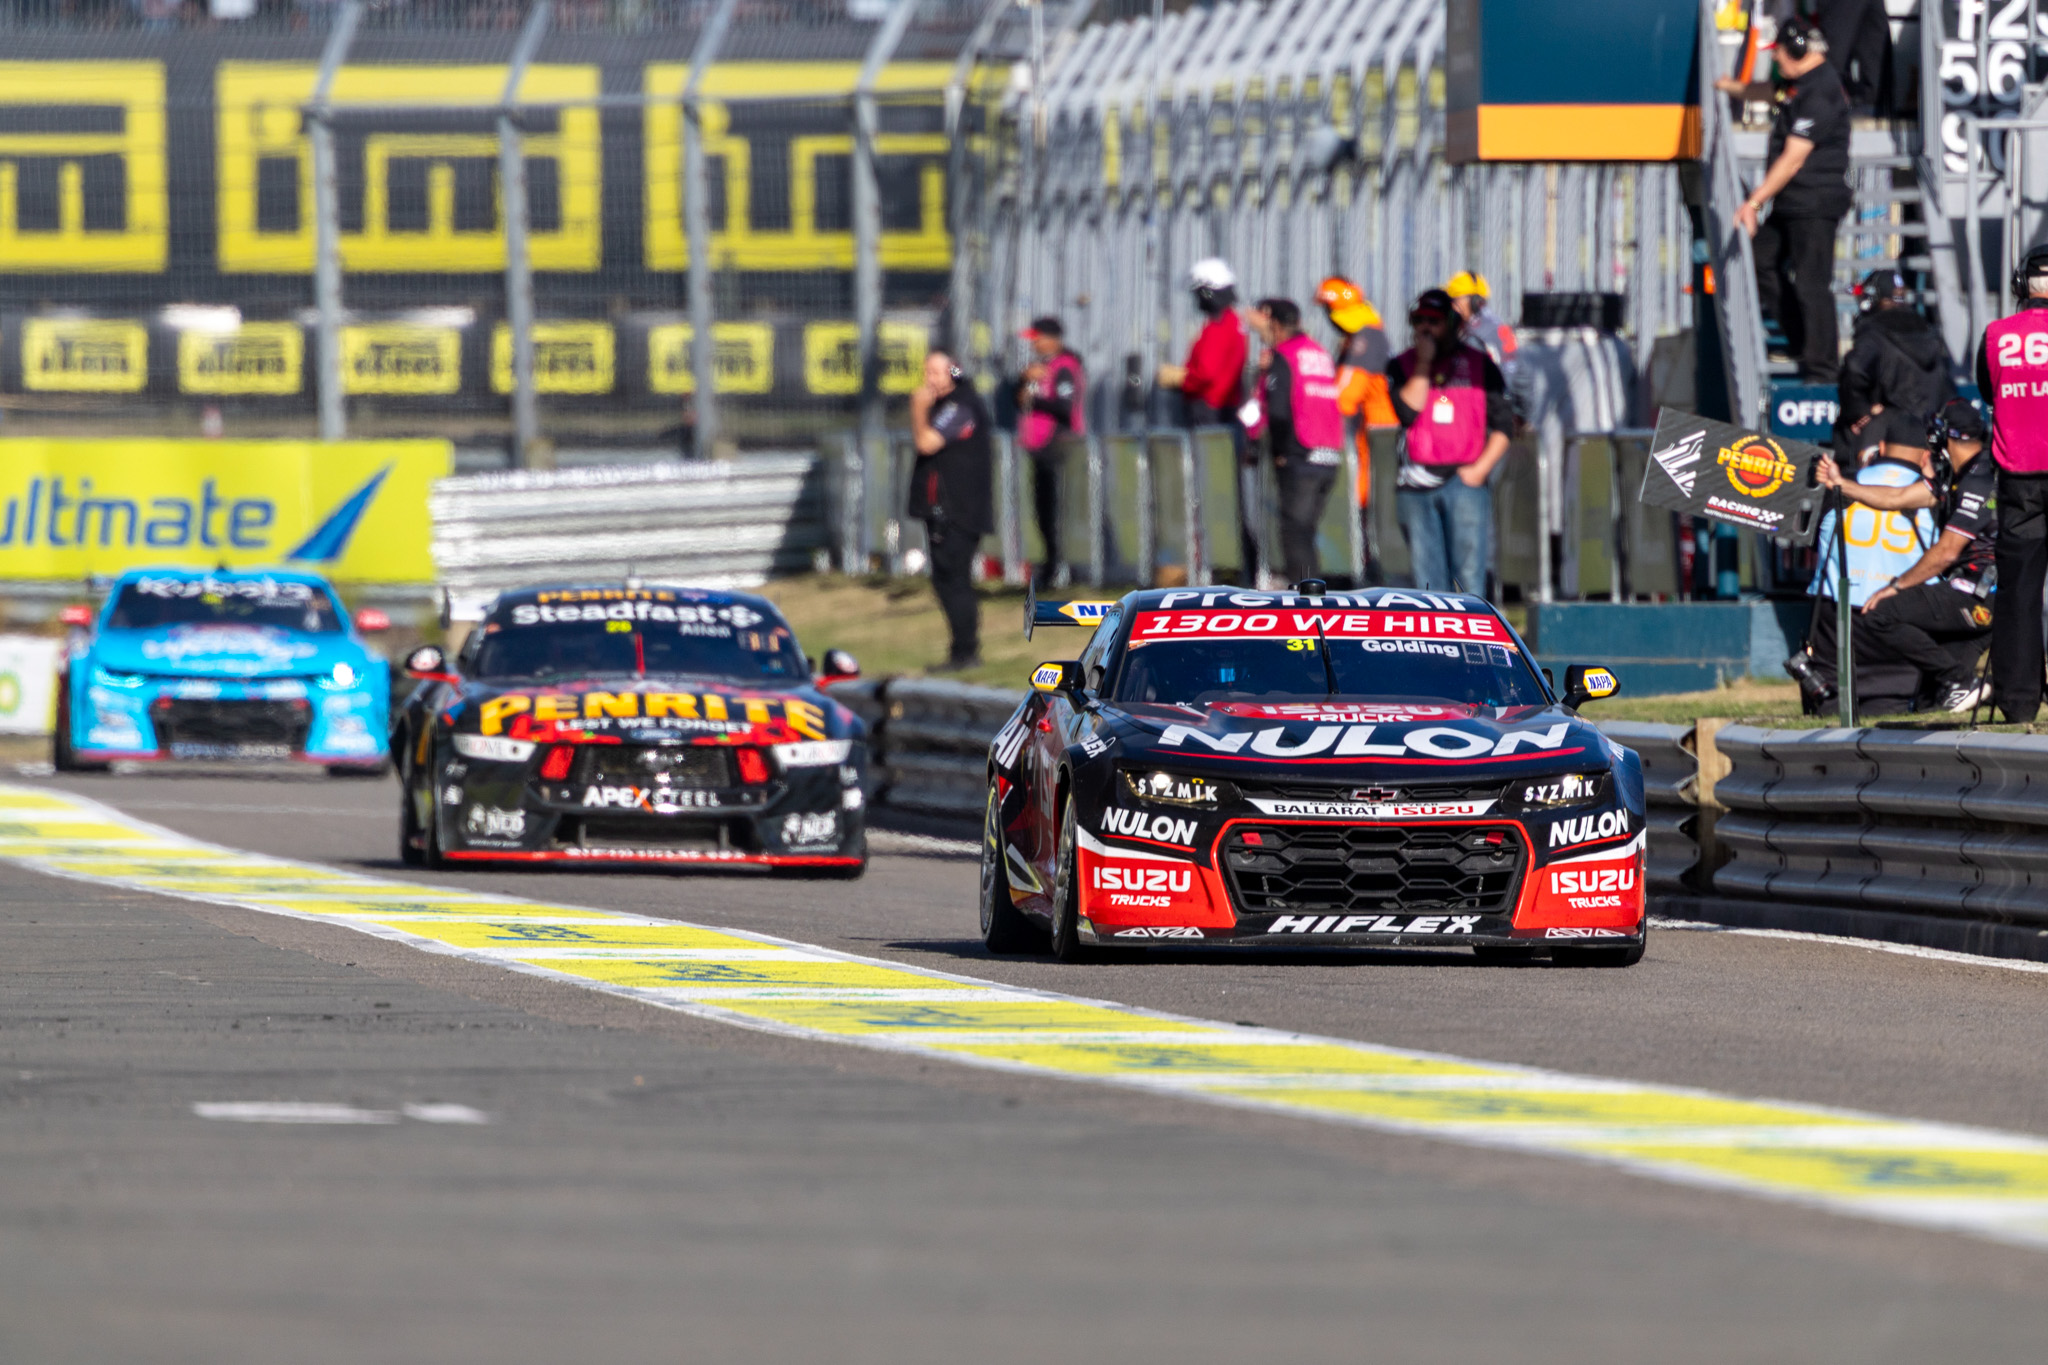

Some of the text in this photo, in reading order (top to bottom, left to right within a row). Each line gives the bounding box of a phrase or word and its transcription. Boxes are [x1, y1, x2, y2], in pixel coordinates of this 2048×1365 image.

[1998, 332, 2048, 367] 26
[2001, 382, 2028, 399] PIT
[1778, 401, 1841, 426] OFFI
[1717, 447, 1797, 483] PENRITE
[1708, 496, 1761, 517] RACING
[512, 601, 717, 625] Steadfast
[1142, 613, 1495, 637] 1300 WE HIRE
[1286, 639, 1315, 651] 31
[1361, 640, 1461, 658] Golding
[1034, 669, 1059, 685] NAPA
[1587, 675, 1612, 690] NAPA
[480, 691, 827, 741] PENRITE
[1262, 704, 1444, 716] ISUZU
[1301, 714, 1414, 723] TRUCKS
[556, 719, 612, 732] LEST
[618, 717, 657, 729] WE
[659, 717, 754, 734] FORGET
[1157, 722, 1570, 757] NULON
[583, 785, 721, 813] APEX STEEL
[1274, 804, 1474, 816] BALLARAT ISUZU
[1100, 806, 1198, 846] NULON
[1549, 808, 1629, 847] NULON
[1093, 866, 1191, 893] ISUZU
[1551, 868, 1635, 894] ISUZU
[1110, 894, 1171, 908] TRUCKS
[1568, 895, 1622, 909] TRUCKS
[1267, 915, 1482, 934] HIFLEX
